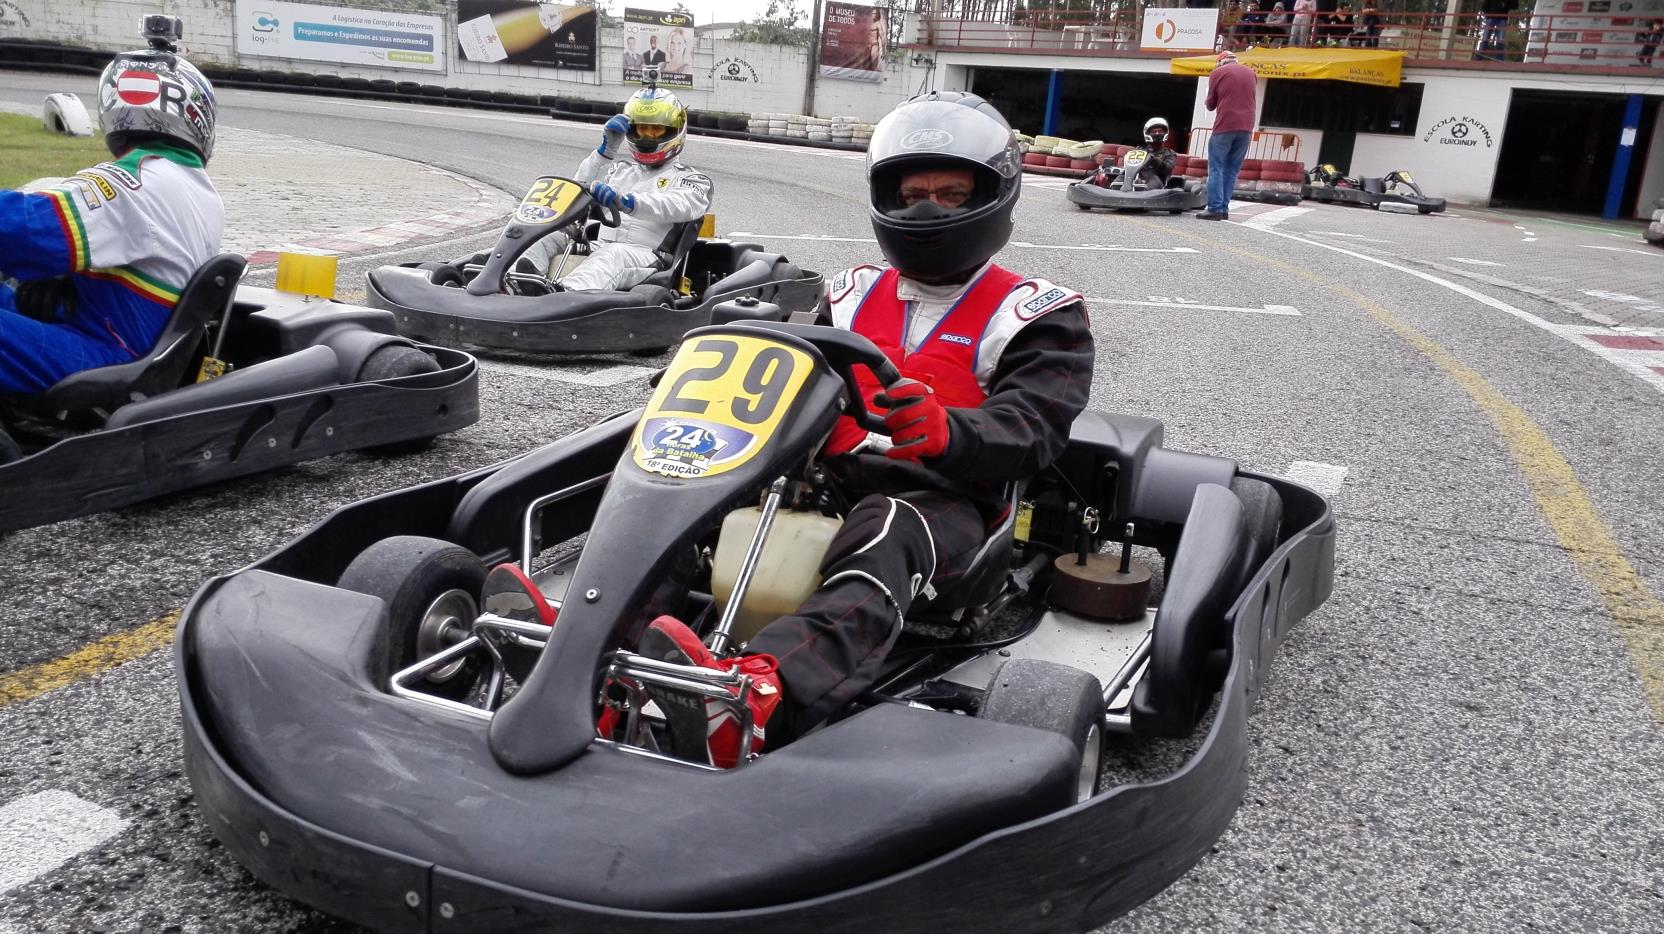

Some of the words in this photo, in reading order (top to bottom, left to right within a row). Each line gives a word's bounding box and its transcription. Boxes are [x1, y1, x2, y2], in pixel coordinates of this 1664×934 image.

[828, 15, 836, 23] DE
[837, 16, 856, 25] TODOS
[835, 8, 856, 17] MUSEU
[337, 15, 362, 26] Logística
[372, 18, 395, 28] Coração
[395, 20, 406, 28] das
[406, 22, 434, 31] Empresas
[298, 27, 334, 39] Preparamos
[339, 30, 371, 42] Expedimos
[392, 36, 429, 46] encomendas
[1424, 116, 1457, 143] ESCOLA
[1462, 116, 1493, 148] KARTING
[1440, 137, 1478, 147] EUROINDY
[1128, 150, 1146, 161] 22
[524, 179, 566, 209] 24
[1026, 290, 1062, 311] sparco
[939, 334, 972, 345] sparco
[658, 339, 796, 425] 29
[659, 425, 702, 449] 24
[652, 446, 664, 455] da
[666, 447, 706, 461] Batalha
[661, 463, 701, 475] EDIÇÃO
